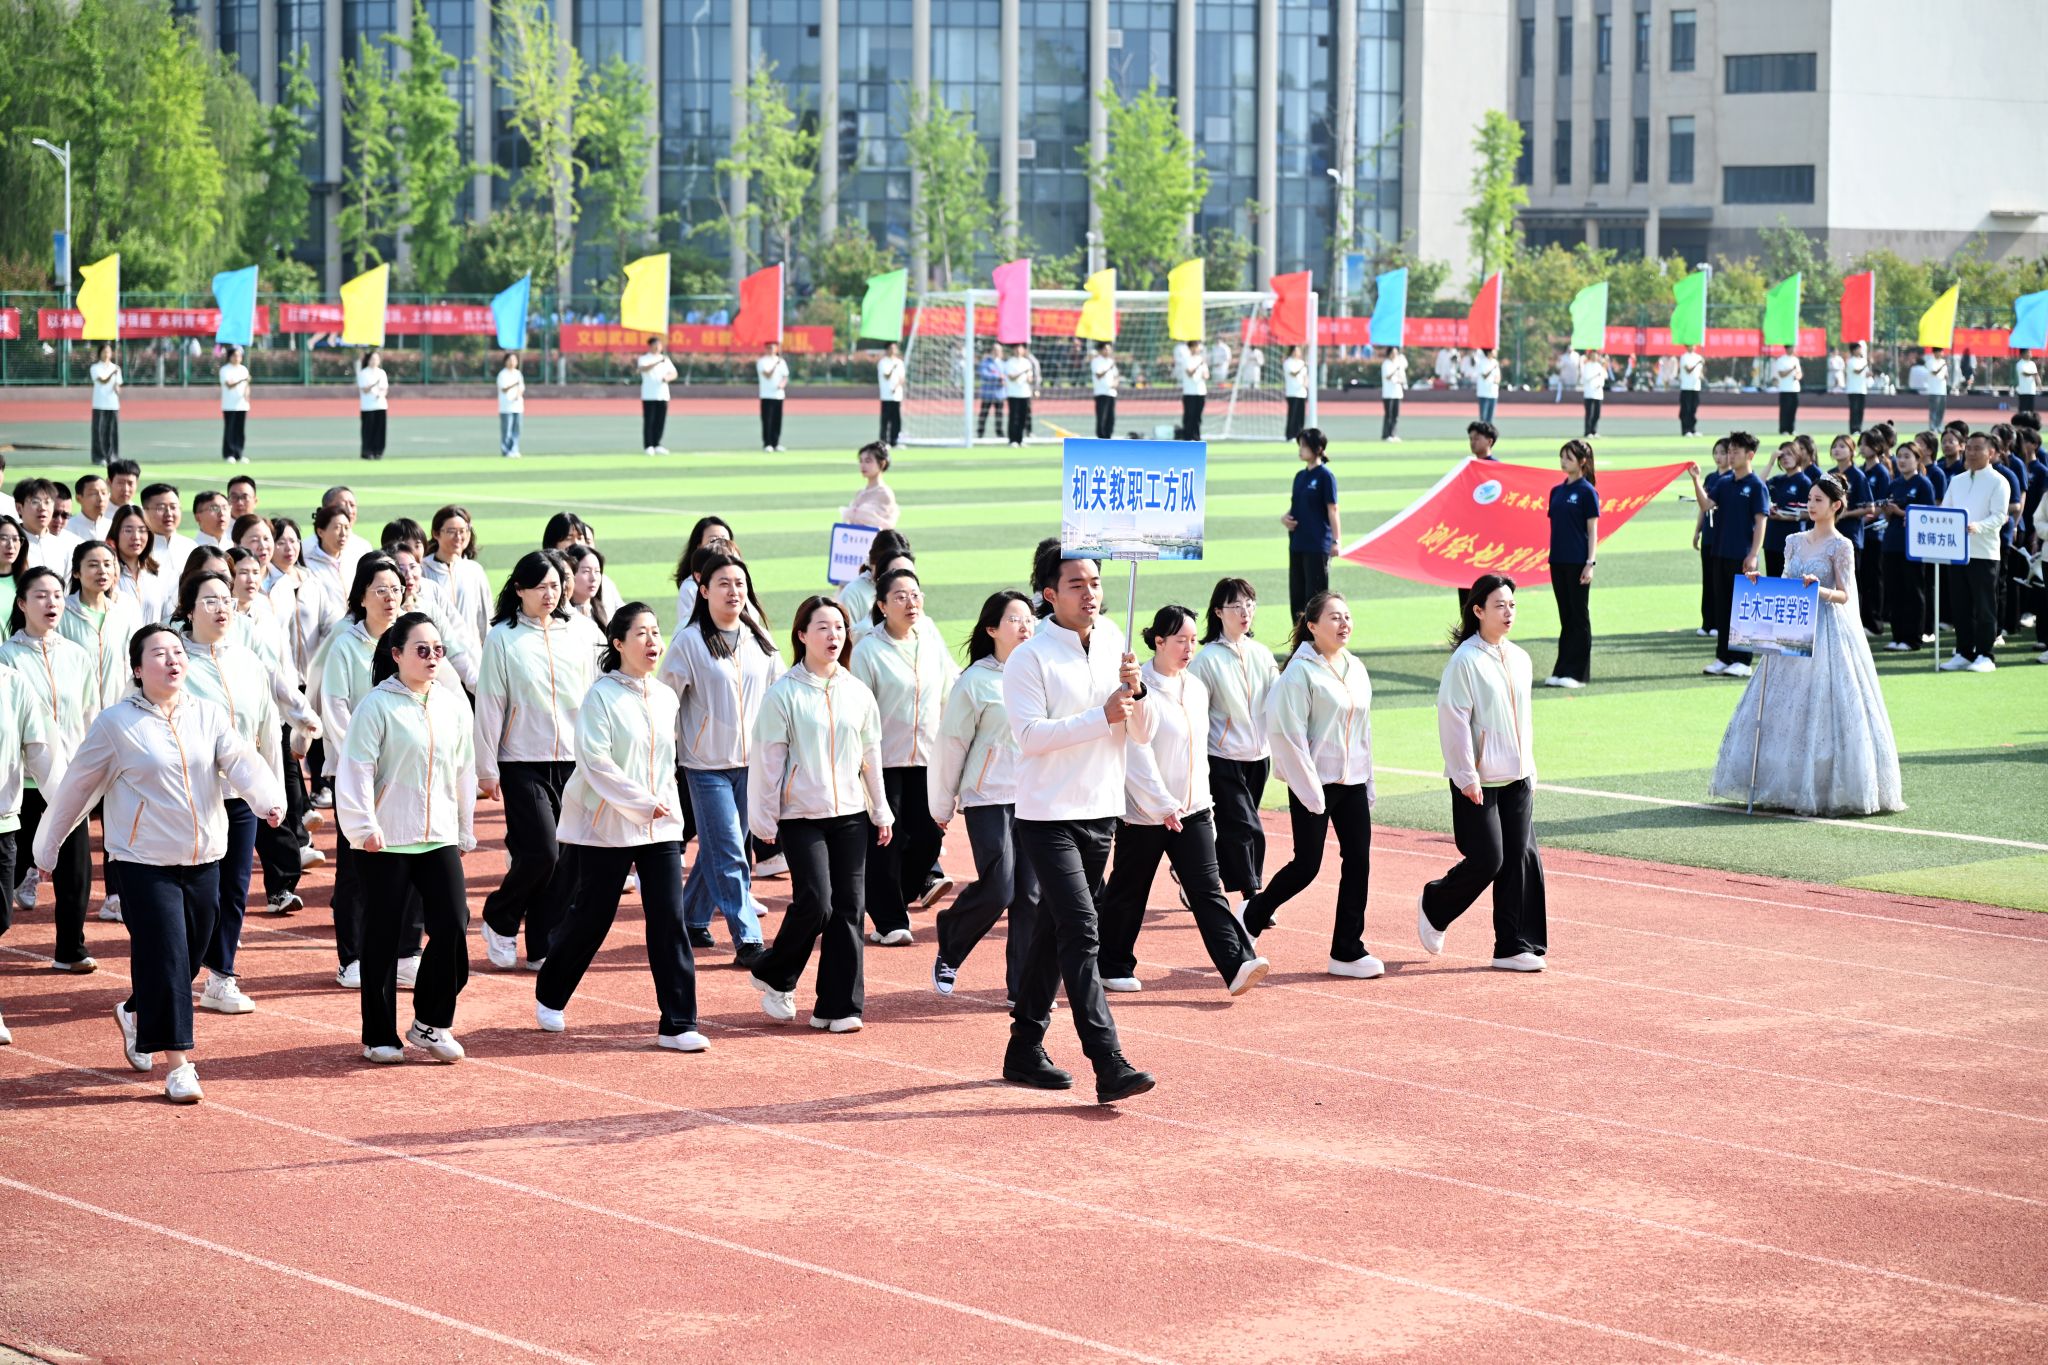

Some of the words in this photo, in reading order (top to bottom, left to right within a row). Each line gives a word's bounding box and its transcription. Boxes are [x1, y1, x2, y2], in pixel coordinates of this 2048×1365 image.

[1072, 466, 1196, 512] 机关教职工方队
[1917, 531, 1957, 547] 教师方队
[1739, 593, 1810, 626] 土木工程学院
